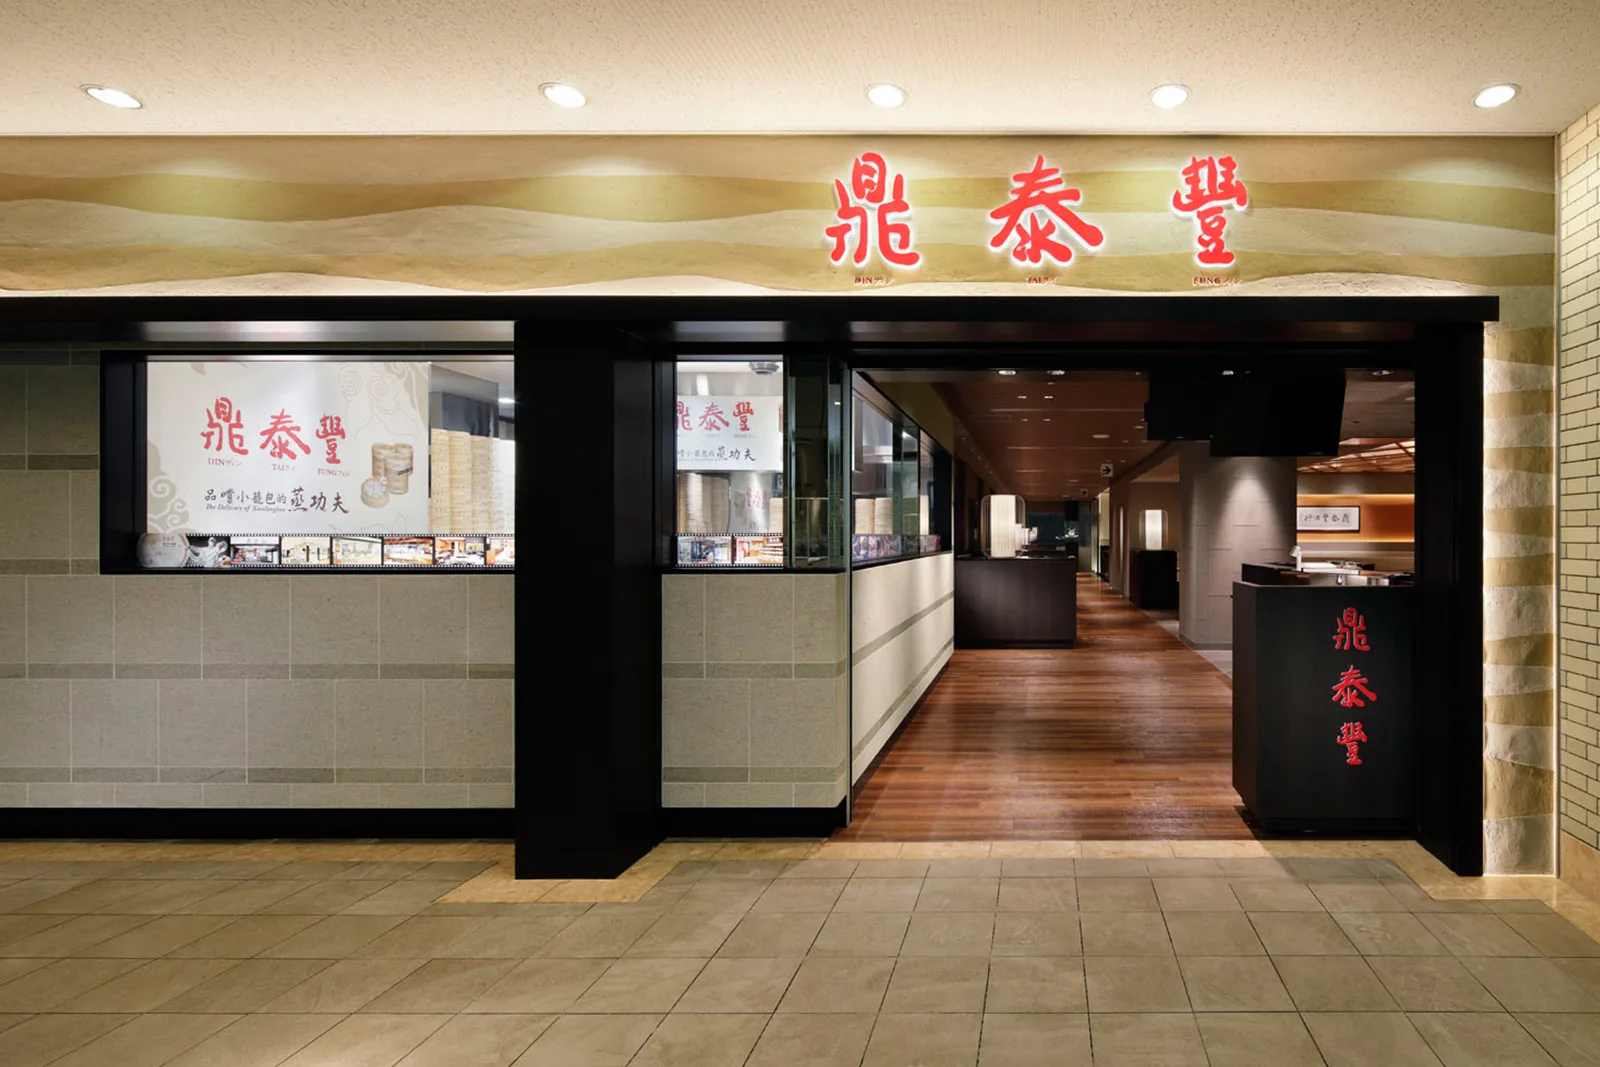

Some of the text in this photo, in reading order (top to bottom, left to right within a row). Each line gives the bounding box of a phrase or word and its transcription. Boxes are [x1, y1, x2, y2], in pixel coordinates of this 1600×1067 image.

[825, 152, 1248, 267] 鼎泰豐
[200, 397, 345, 465] 鼎泰豐
[1332, 607, 1378, 766] 鼎泰豐
